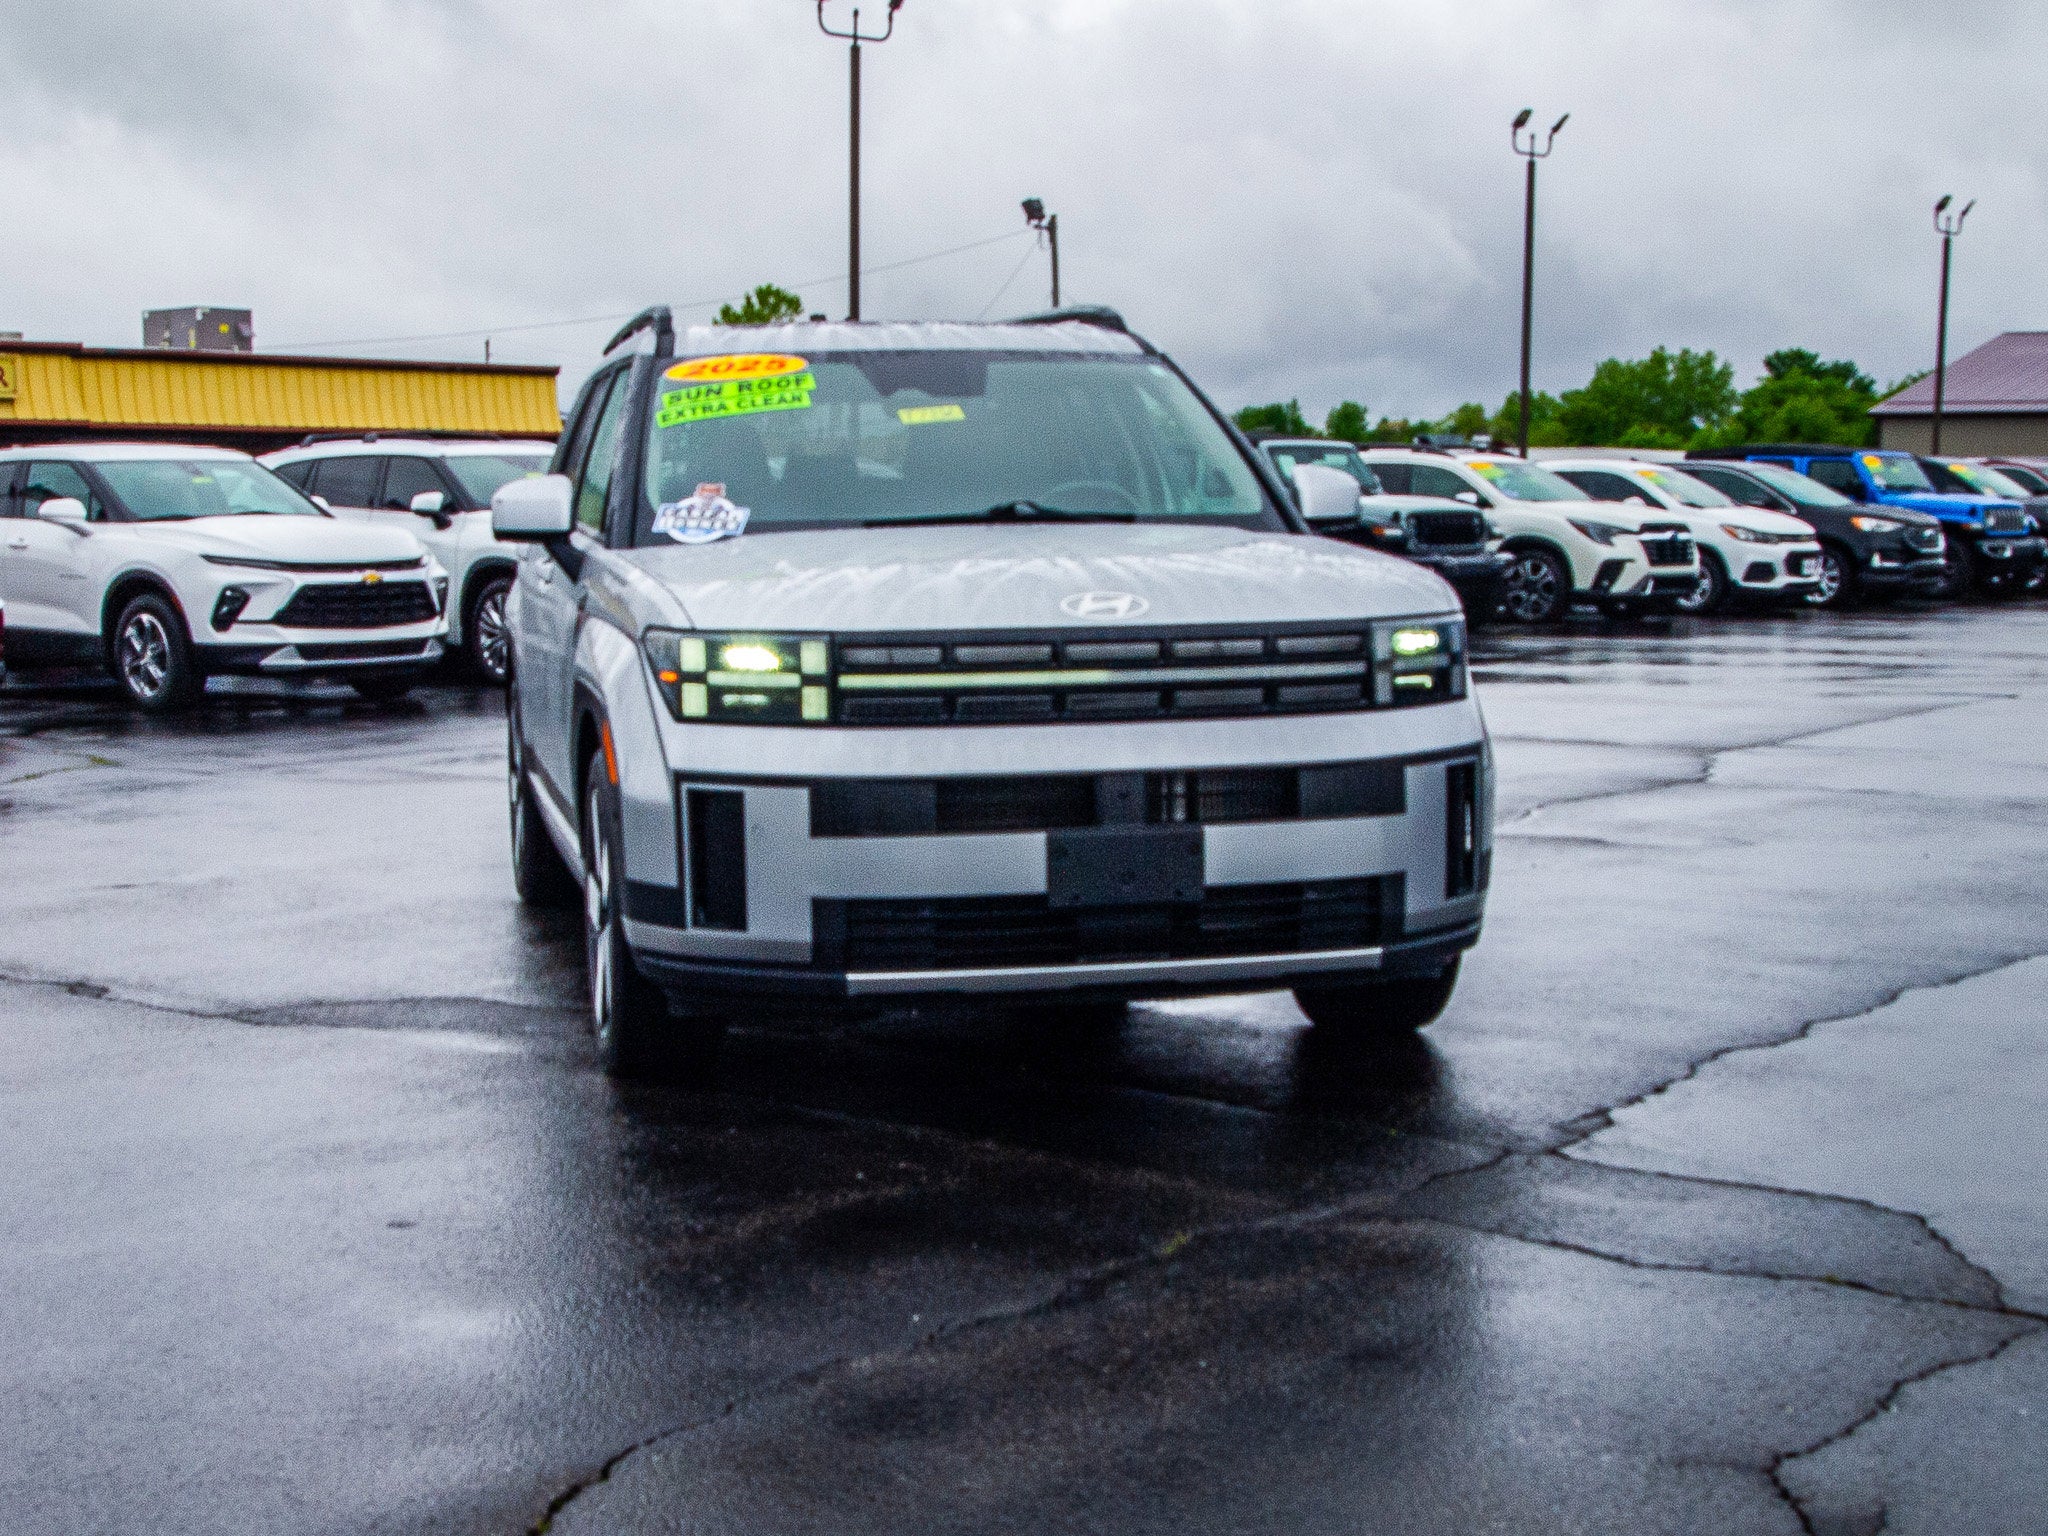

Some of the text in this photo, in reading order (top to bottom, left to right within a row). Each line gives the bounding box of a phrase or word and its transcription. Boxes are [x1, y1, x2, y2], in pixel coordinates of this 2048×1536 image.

[669, 374, 807, 406] SUN ROOF
[661, 393, 803, 424] EXTRA CLEAN
